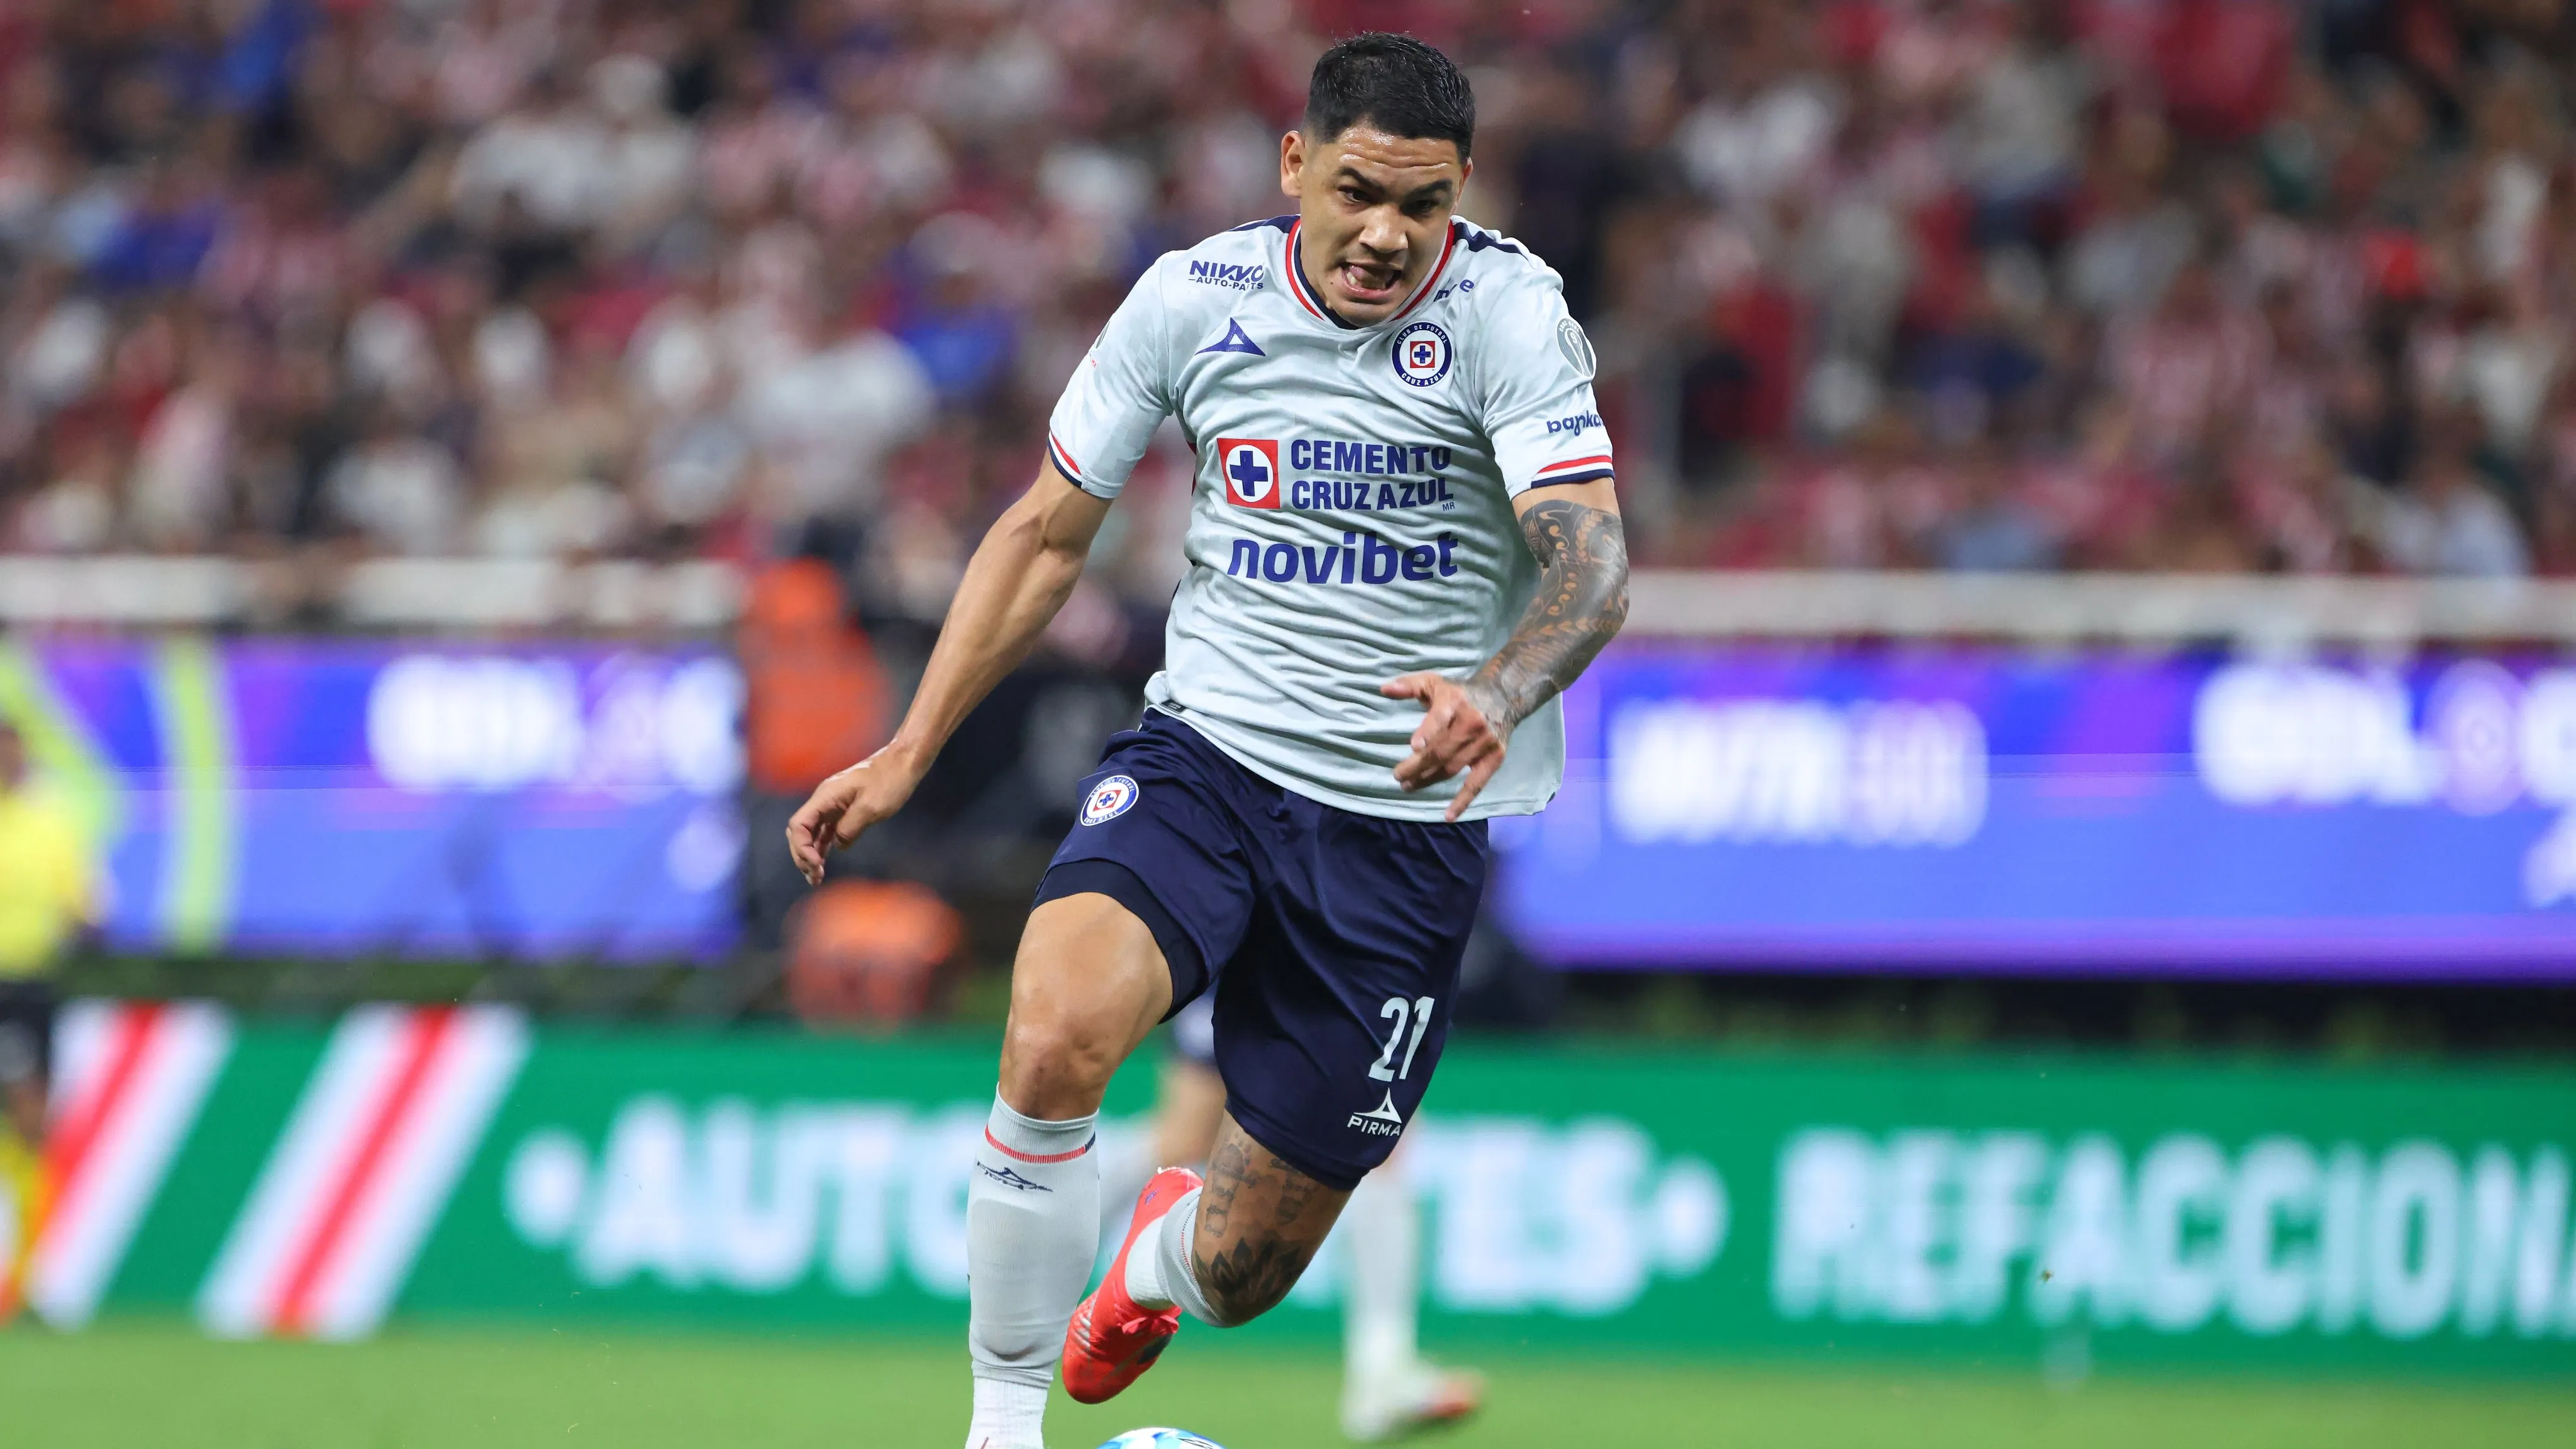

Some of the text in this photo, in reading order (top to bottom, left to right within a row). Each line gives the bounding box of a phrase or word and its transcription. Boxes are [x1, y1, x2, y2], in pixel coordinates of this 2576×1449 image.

[1196, 277, 1263, 291] AUTO-PATS
[1397, 329, 1411, 345] CLUB
[1426, 325, 1448, 344] FUTBOL
[1401, 372, 1443, 386] CRUZ AZUL
[1291, 439, 1452, 475] CEMENTO
[1292, 477, 1454, 511] CRUZ AZUL
[1227, 531, 1458, 585] novibet
[1368, 996, 1435, 1082] 21
[1347, 1115, 1401, 1136] PIRMA
